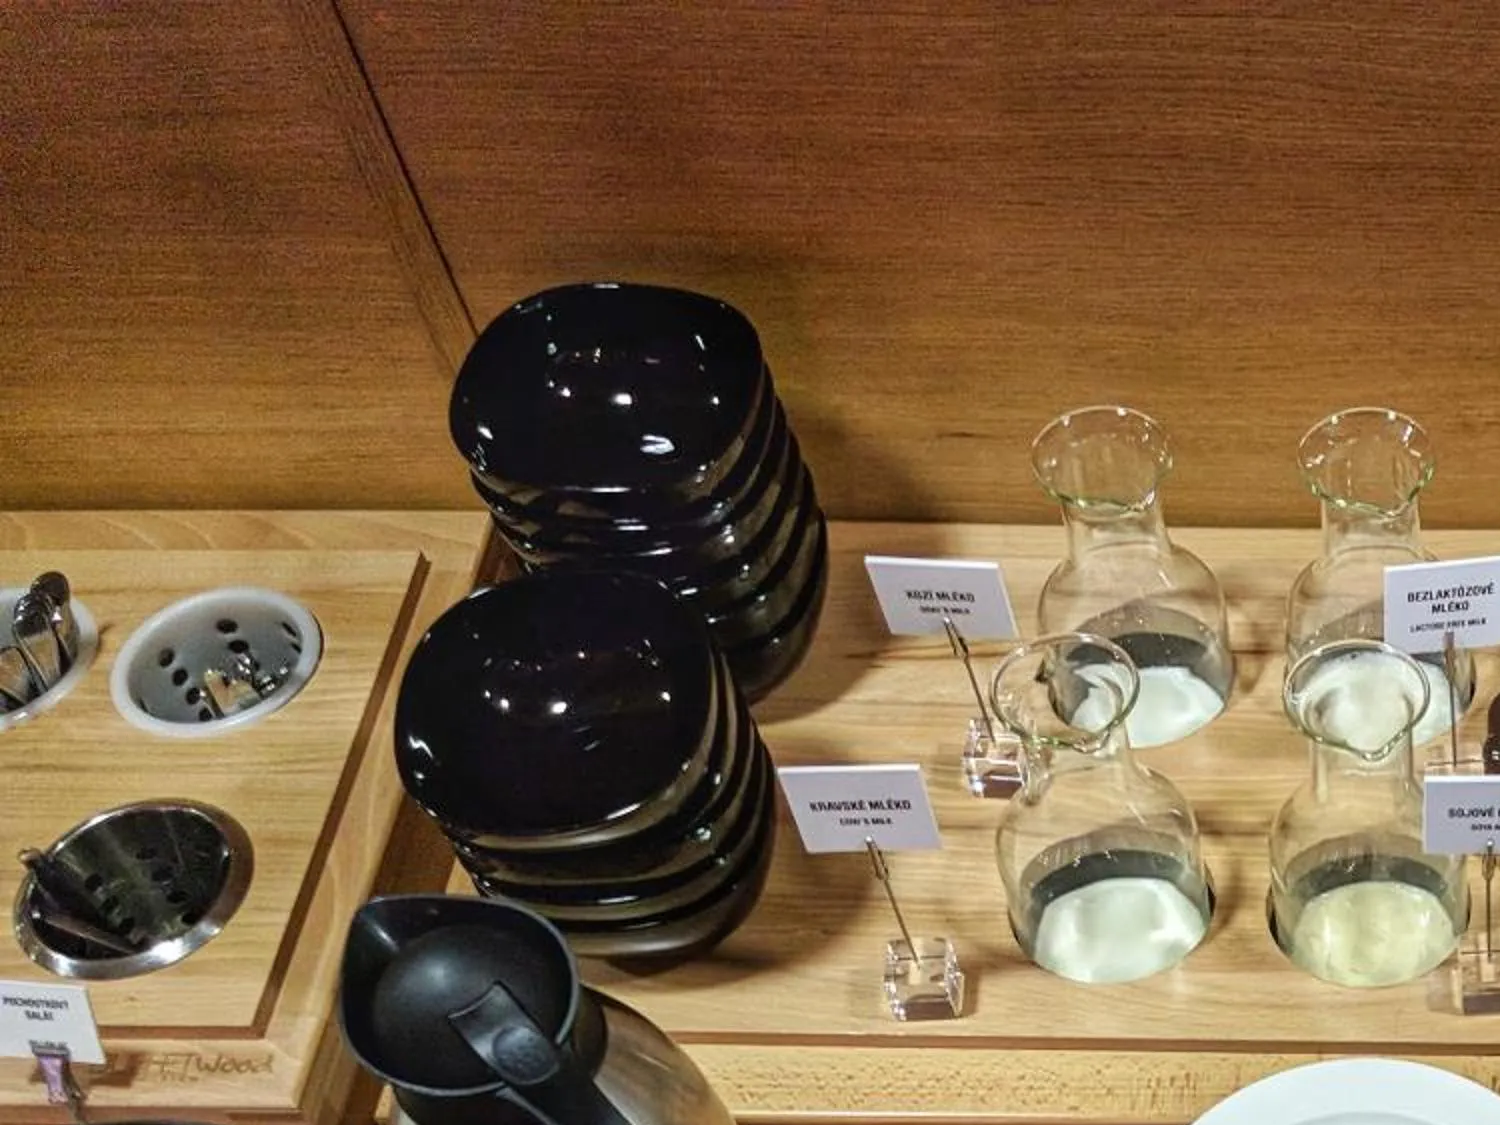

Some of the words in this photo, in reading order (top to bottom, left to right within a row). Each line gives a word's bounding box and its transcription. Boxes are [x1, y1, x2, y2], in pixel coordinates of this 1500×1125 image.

[935, 589, 975, 603] MLÉKO
[1407, 581, 1495, 603] BEZLAKTÓZOVÉ
[1431, 600, 1469, 614] MLÉKO
[1467, 617, 1487, 626] MILK
[809, 798, 866, 812] KRAVSKÉ
[868, 798, 912, 811] MLÉKO
[1448, 805, 1496, 819] SOJOVÉ
